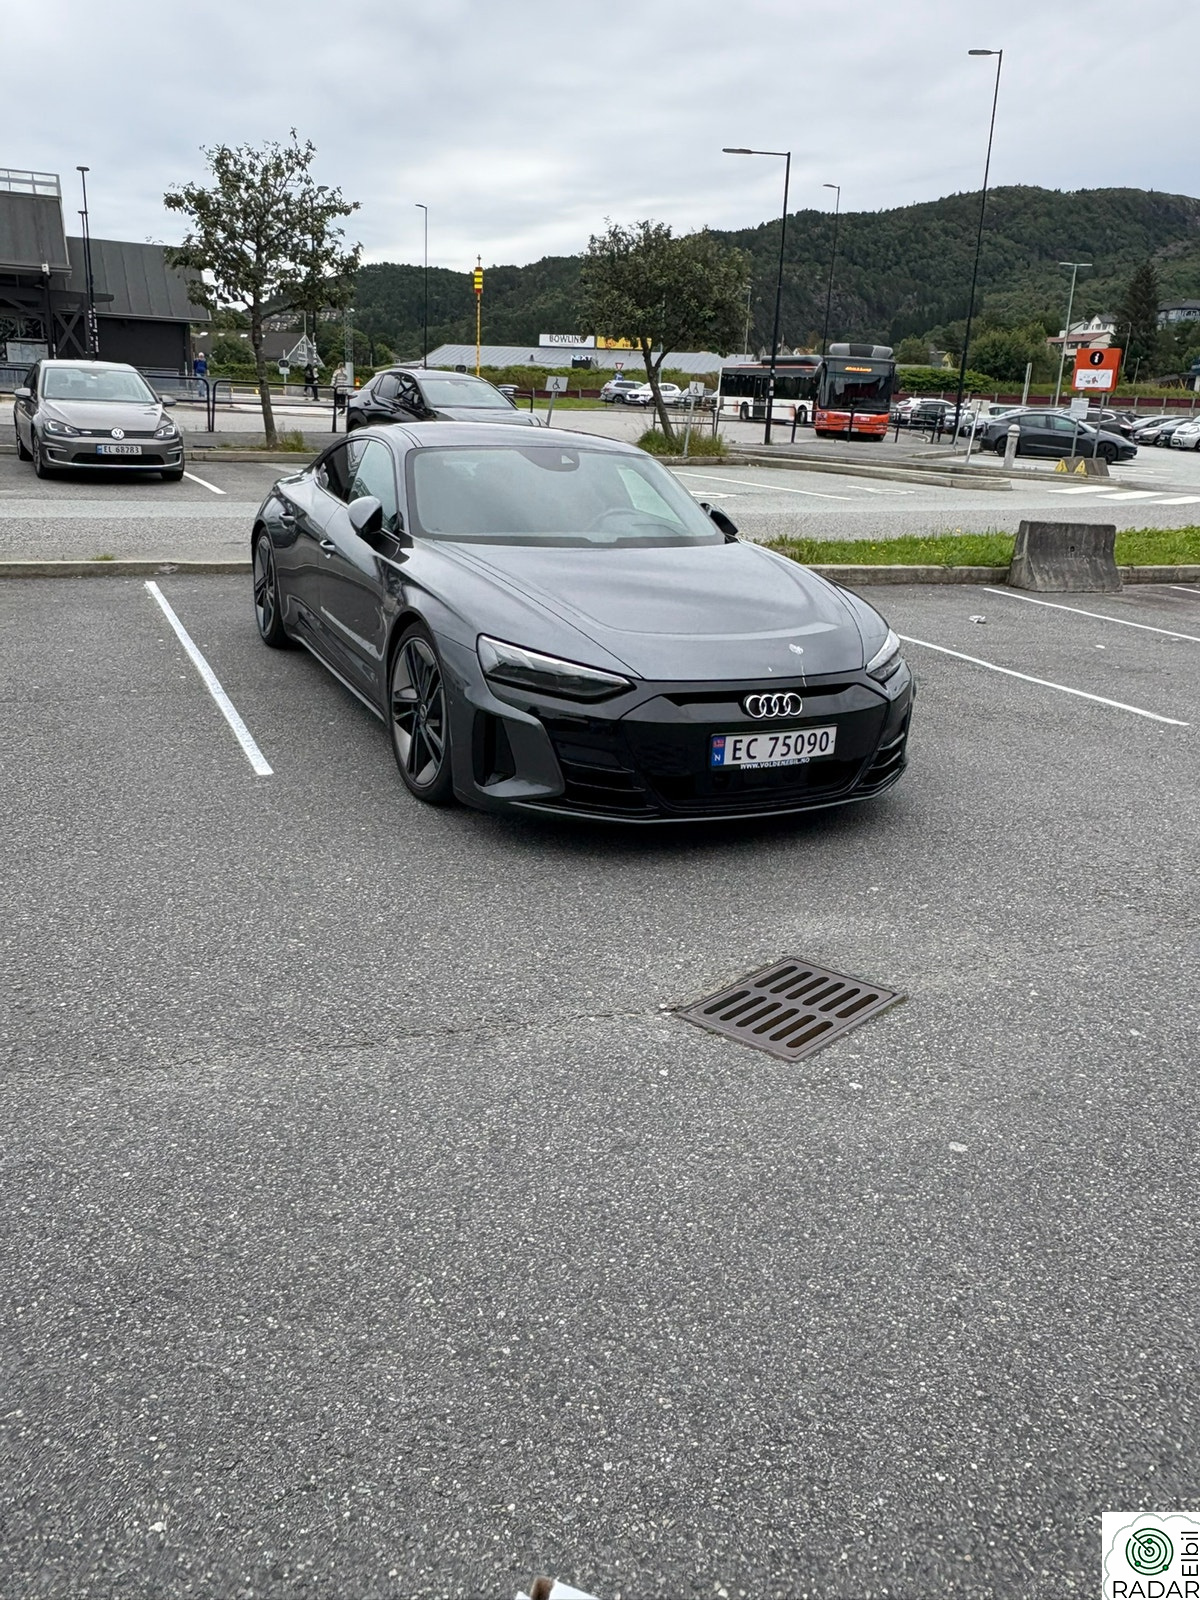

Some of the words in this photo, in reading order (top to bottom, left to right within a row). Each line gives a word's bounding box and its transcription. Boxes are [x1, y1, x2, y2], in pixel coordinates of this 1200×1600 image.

[549, 335, 586, 343] BOWLING
[103, 445, 113, 454] EL
[731, 738, 758, 761] EC
[768, 731, 829, 758] 75090
[714, 753, 721, 761] N
